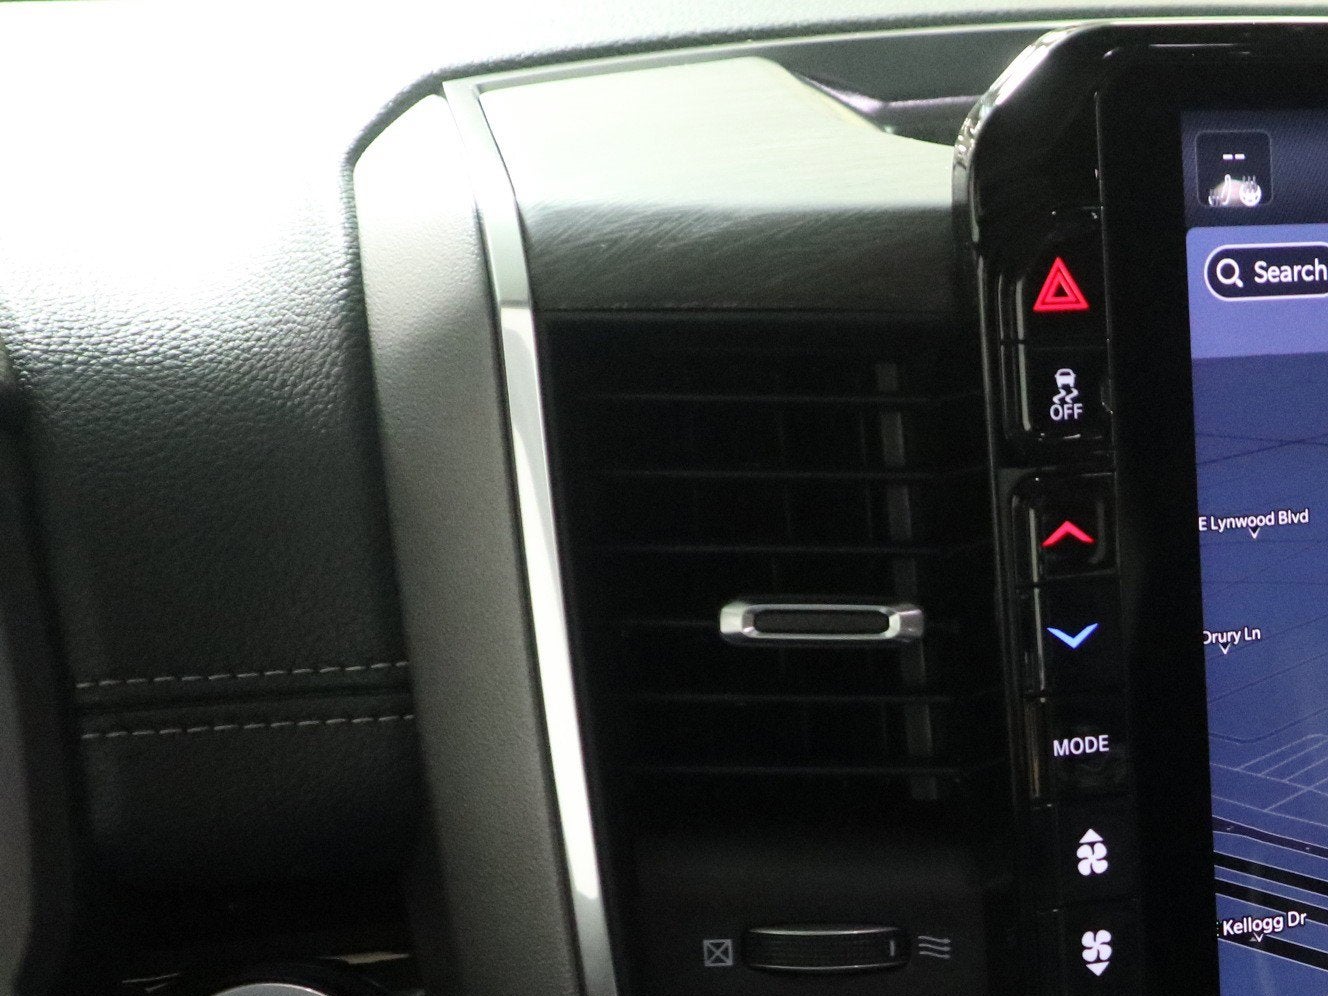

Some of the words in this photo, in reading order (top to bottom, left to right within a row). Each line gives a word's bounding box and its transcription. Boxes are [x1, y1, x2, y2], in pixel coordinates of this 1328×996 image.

[1254, 258, 1328, 283] Search
[1050, 403, 1083, 420] OFF
[1198, 516, 1207, 531] E
[1210, 511, 1275, 533] Lynwood
[1278, 508, 1309, 525] Blvd
[1244, 627, 1261, 641] Ln
[1053, 735, 1110, 757] MODE
[1222, 915, 1284, 936] Kellogg
[1287, 911, 1307, 927] Dr
